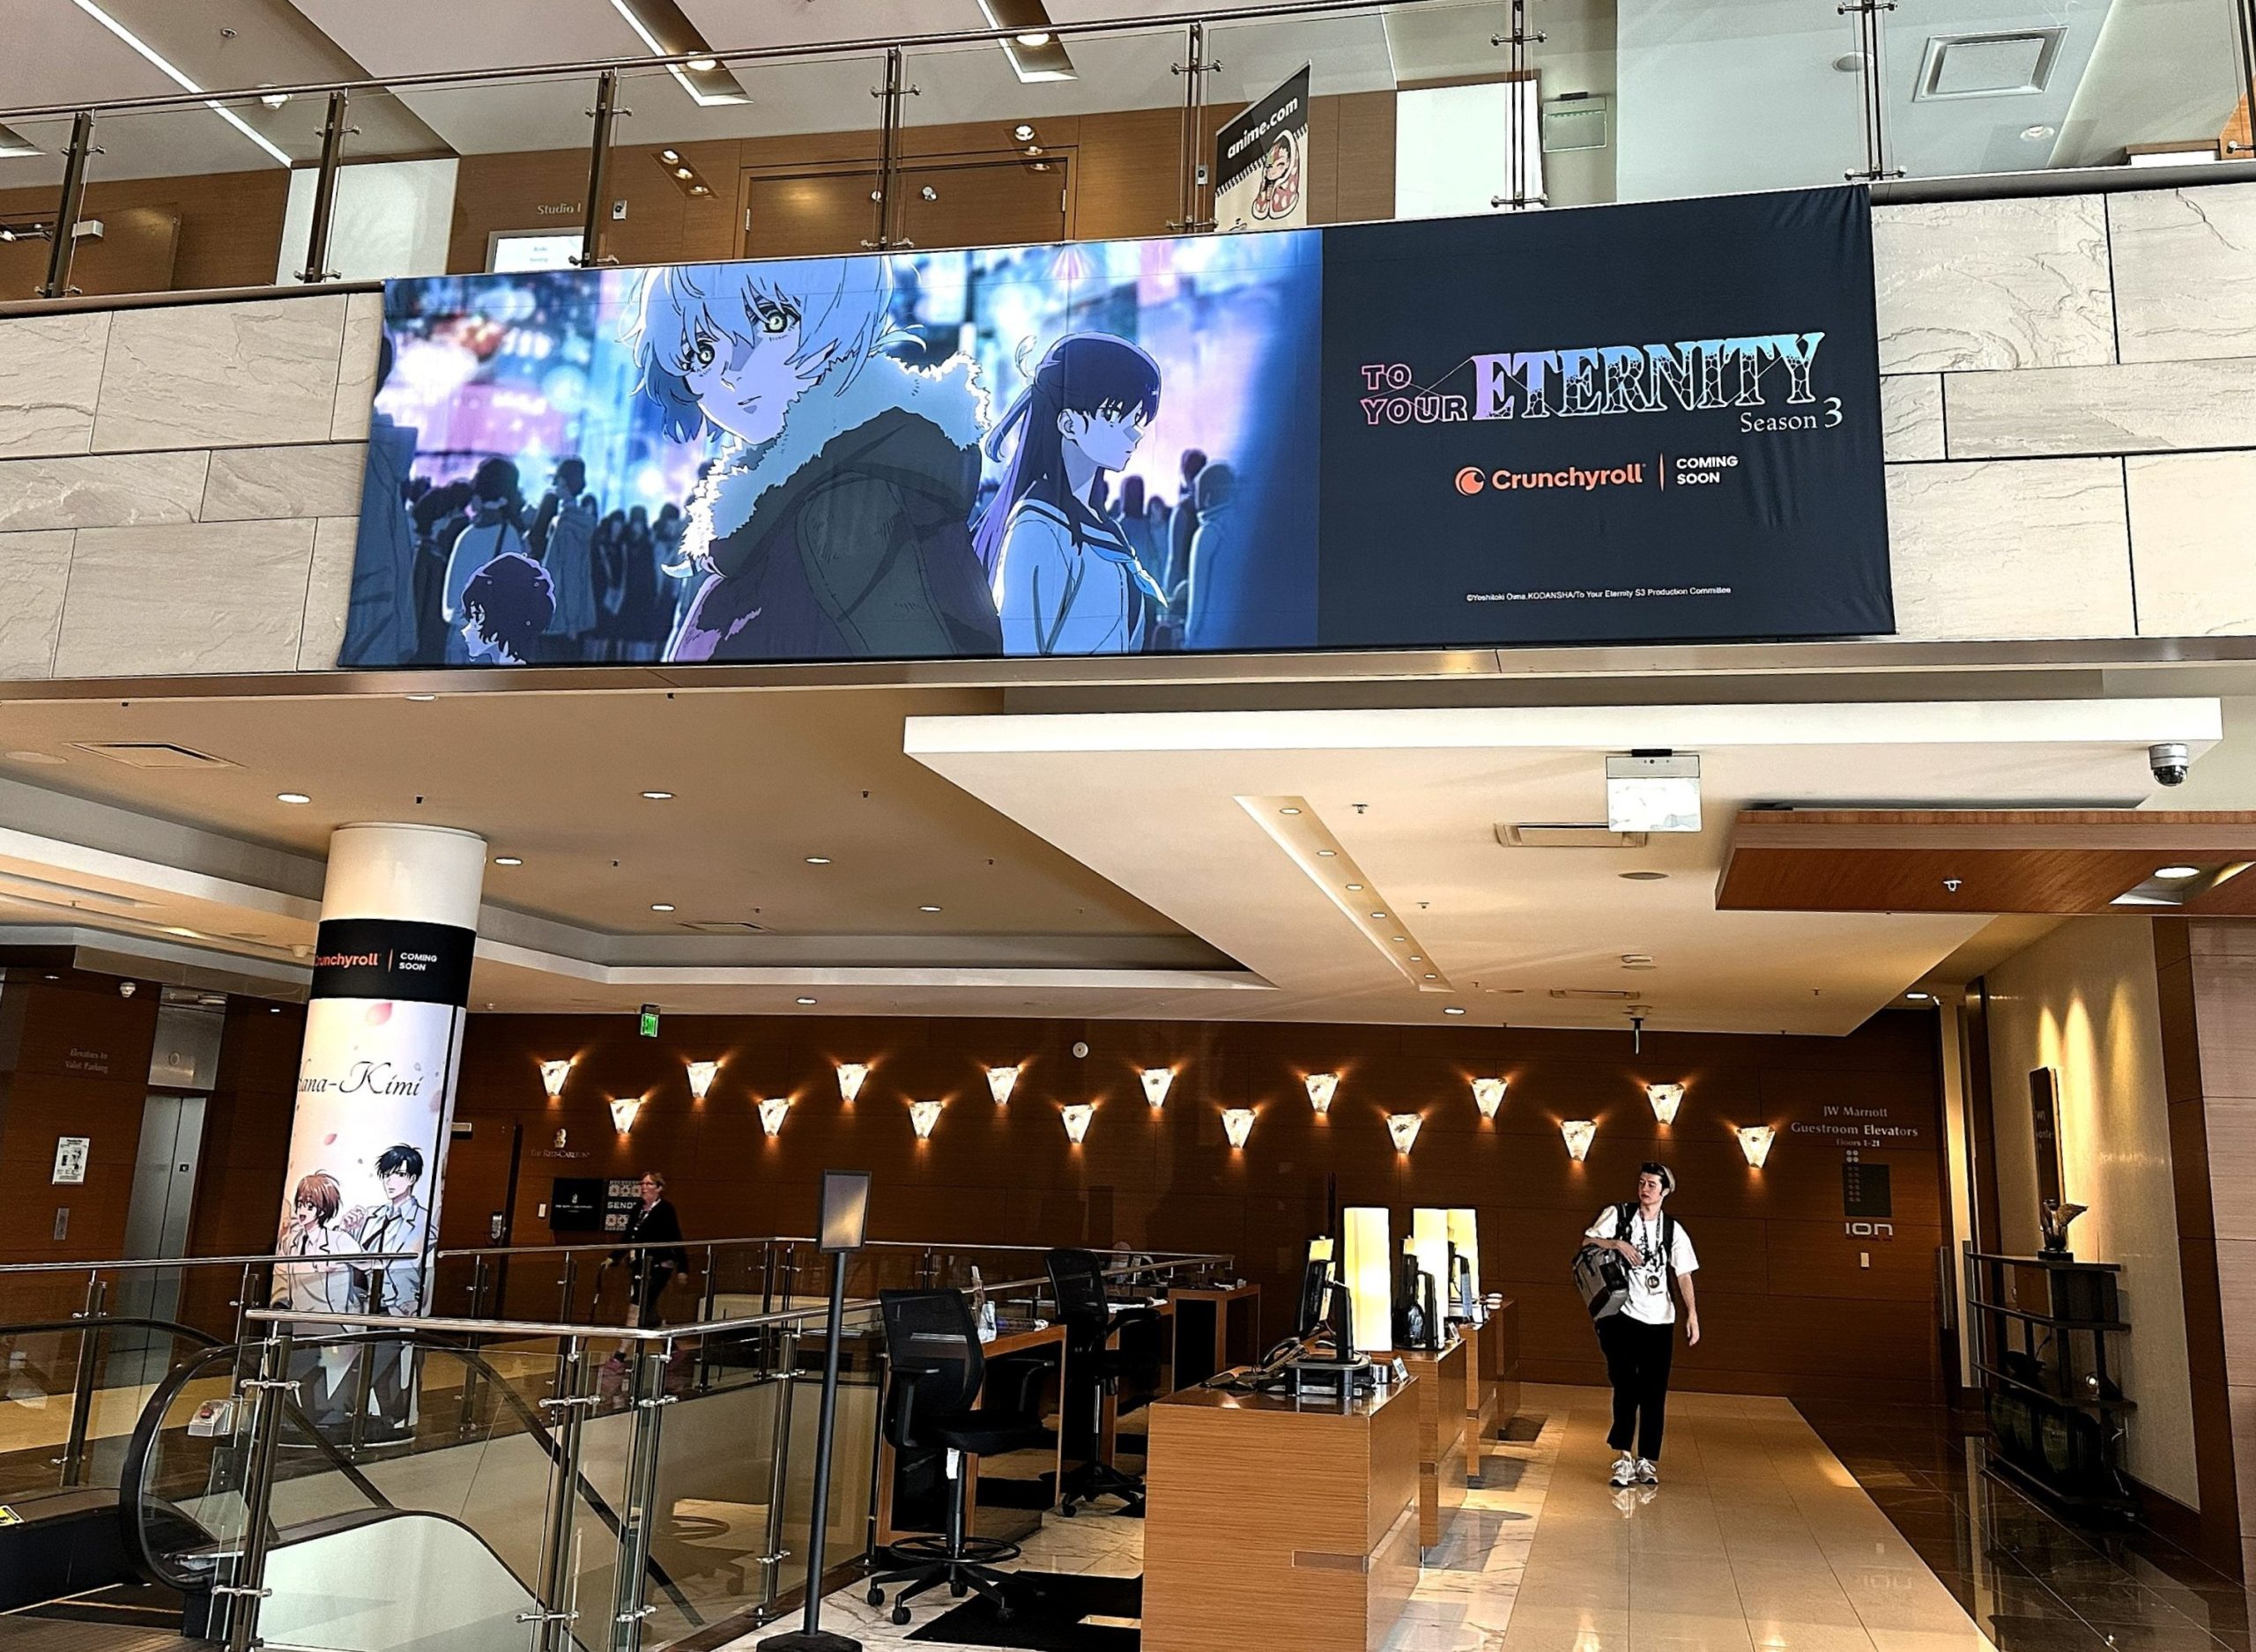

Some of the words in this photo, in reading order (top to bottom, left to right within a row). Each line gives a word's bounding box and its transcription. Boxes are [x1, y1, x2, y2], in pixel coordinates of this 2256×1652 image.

[1228, 97, 1298, 159] anime.com
[537, 204, 575, 215] Studio
[1361, 395, 1467, 425] YOUR
[1472, 331, 1825, 420] ETERNITY
[1362, 364, 1412, 390] TO
[1740, 411, 1818, 433] Season
[1823, 396, 1844, 428] 3
[1676, 456, 1738, 469] COMING
[1492, 463, 1644, 491] Crunchyroll
[1677, 472, 1720, 485] SOON
[1605, 589, 1633, 598] Eternity
[1647, 588, 1688, 596] Production
[400, 952, 437, 962] COMING
[399, 962, 427, 971] SOON
[1823, 1106, 1839, 1116] JW
[1844, 1107, 1888, 1117] Marriott
[1791, 1122, 1859, 1135] Guestroom
[1864, 1124, 1918, 1137] Elevators
